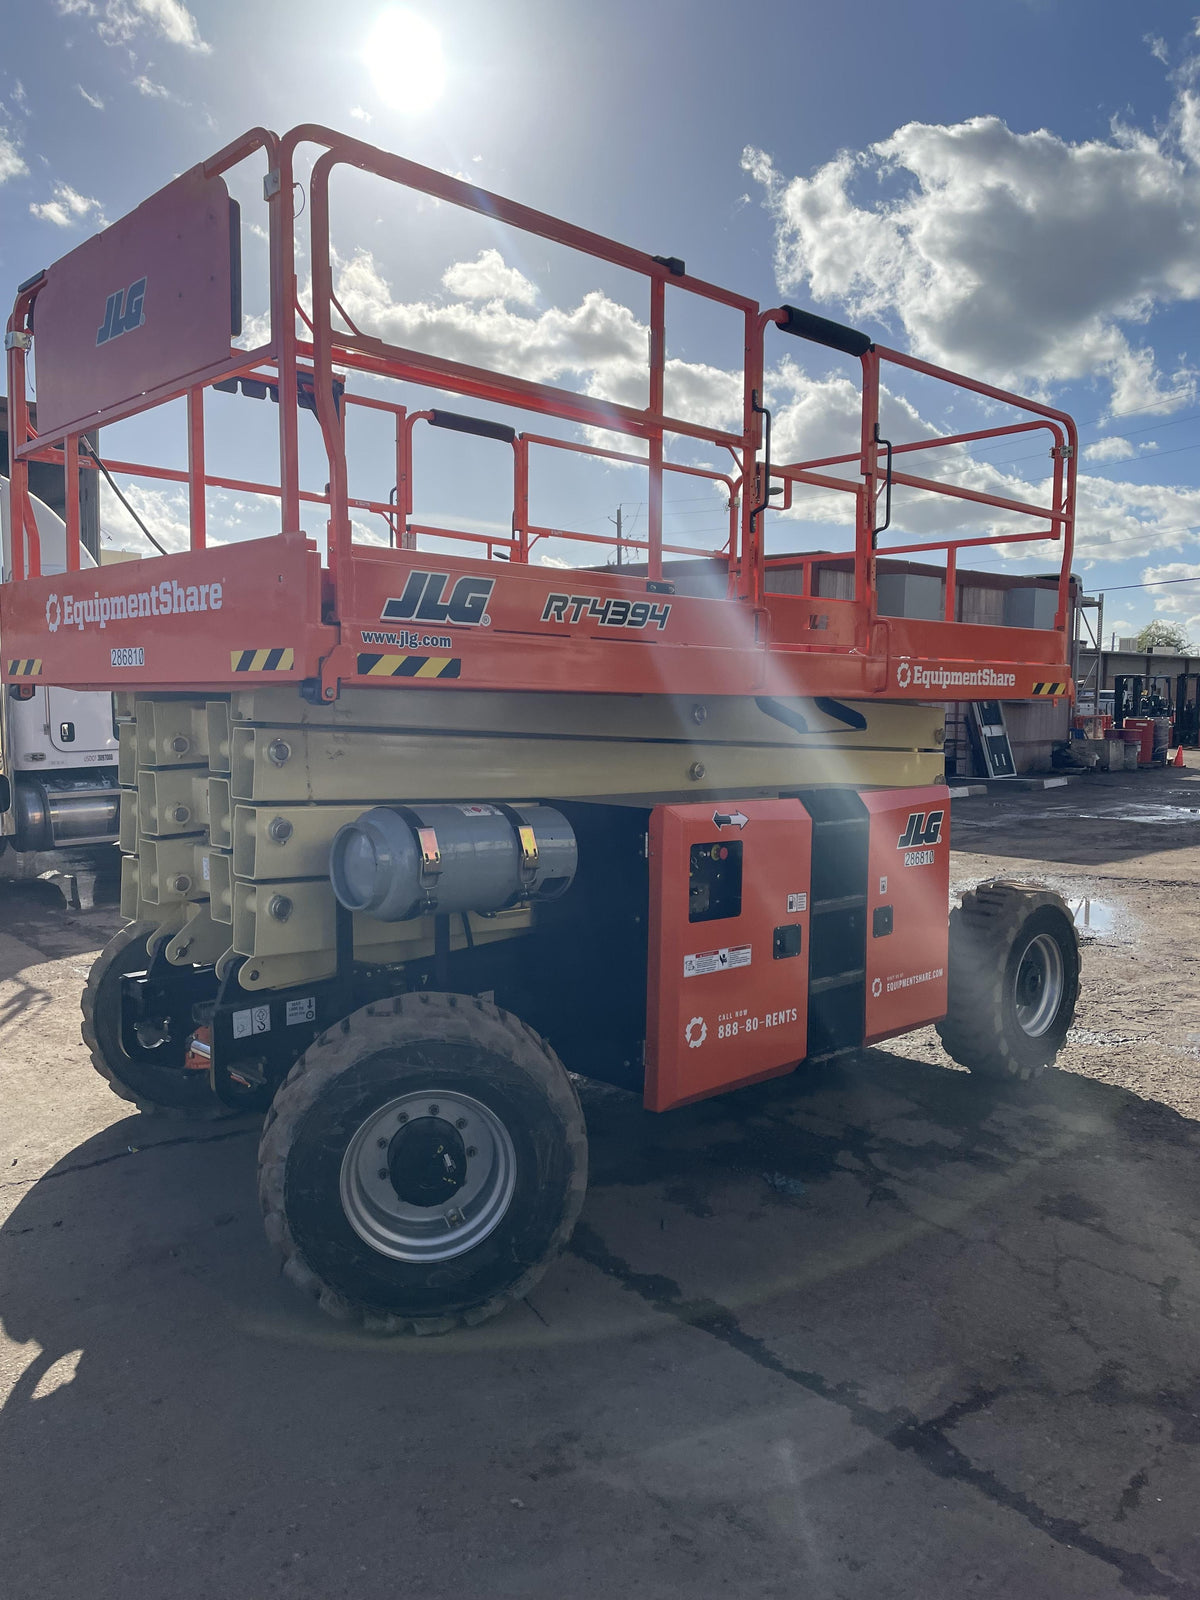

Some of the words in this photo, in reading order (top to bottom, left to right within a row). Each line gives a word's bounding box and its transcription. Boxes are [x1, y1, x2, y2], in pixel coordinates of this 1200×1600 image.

[96, 276, 147, 347] JLG
[63, 580, 223, 630] EquipmentShare
[541, 593, 671, 630] RT4394
[361, 630, 452, 648] www.jlg.com
[111, 648, 144, 666] 286810
[913, 666, 1016, 688] EquipmentShare
[897, 810, 944, 849] JLG
[905, 851, 934, 866] 286810
[887, 968, 944, 992] EQUIPMENTSHARE.COM
[718, 1012, 733, 1022] CALL
[718, 1008, 797, 1039] 888-80-RENTS
